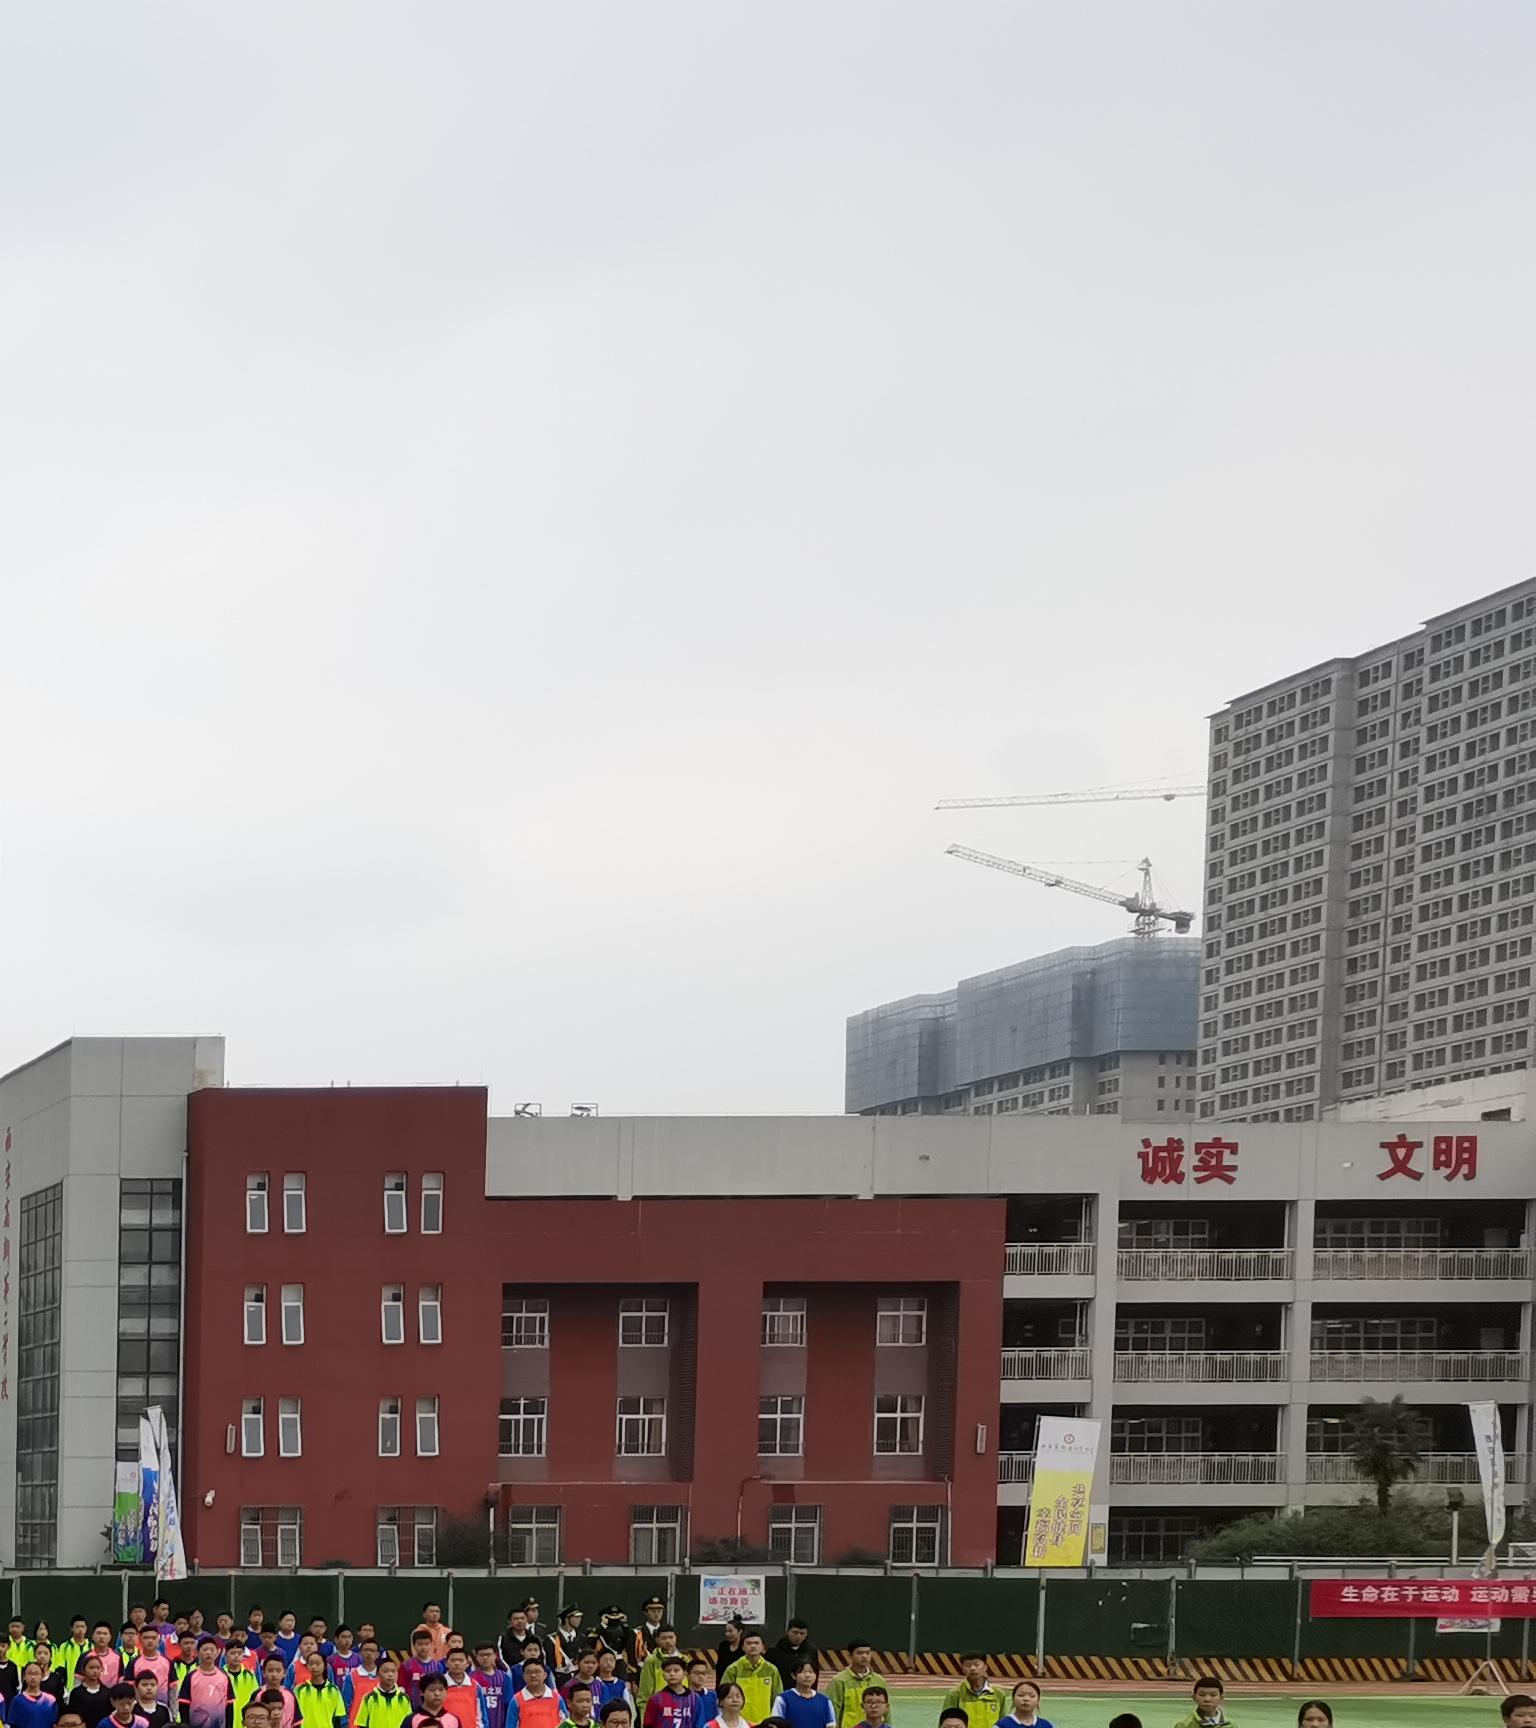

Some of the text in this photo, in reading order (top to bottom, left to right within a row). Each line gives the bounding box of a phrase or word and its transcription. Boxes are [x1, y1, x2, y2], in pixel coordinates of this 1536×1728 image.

[1137, 1137, 1239, 1185] 诚实
[1376, 1133, 1478, 1182] 文明
[1340, 1585, 1460, 1602] 生命在于运动
[486, 1696, 497, 1708] 15
